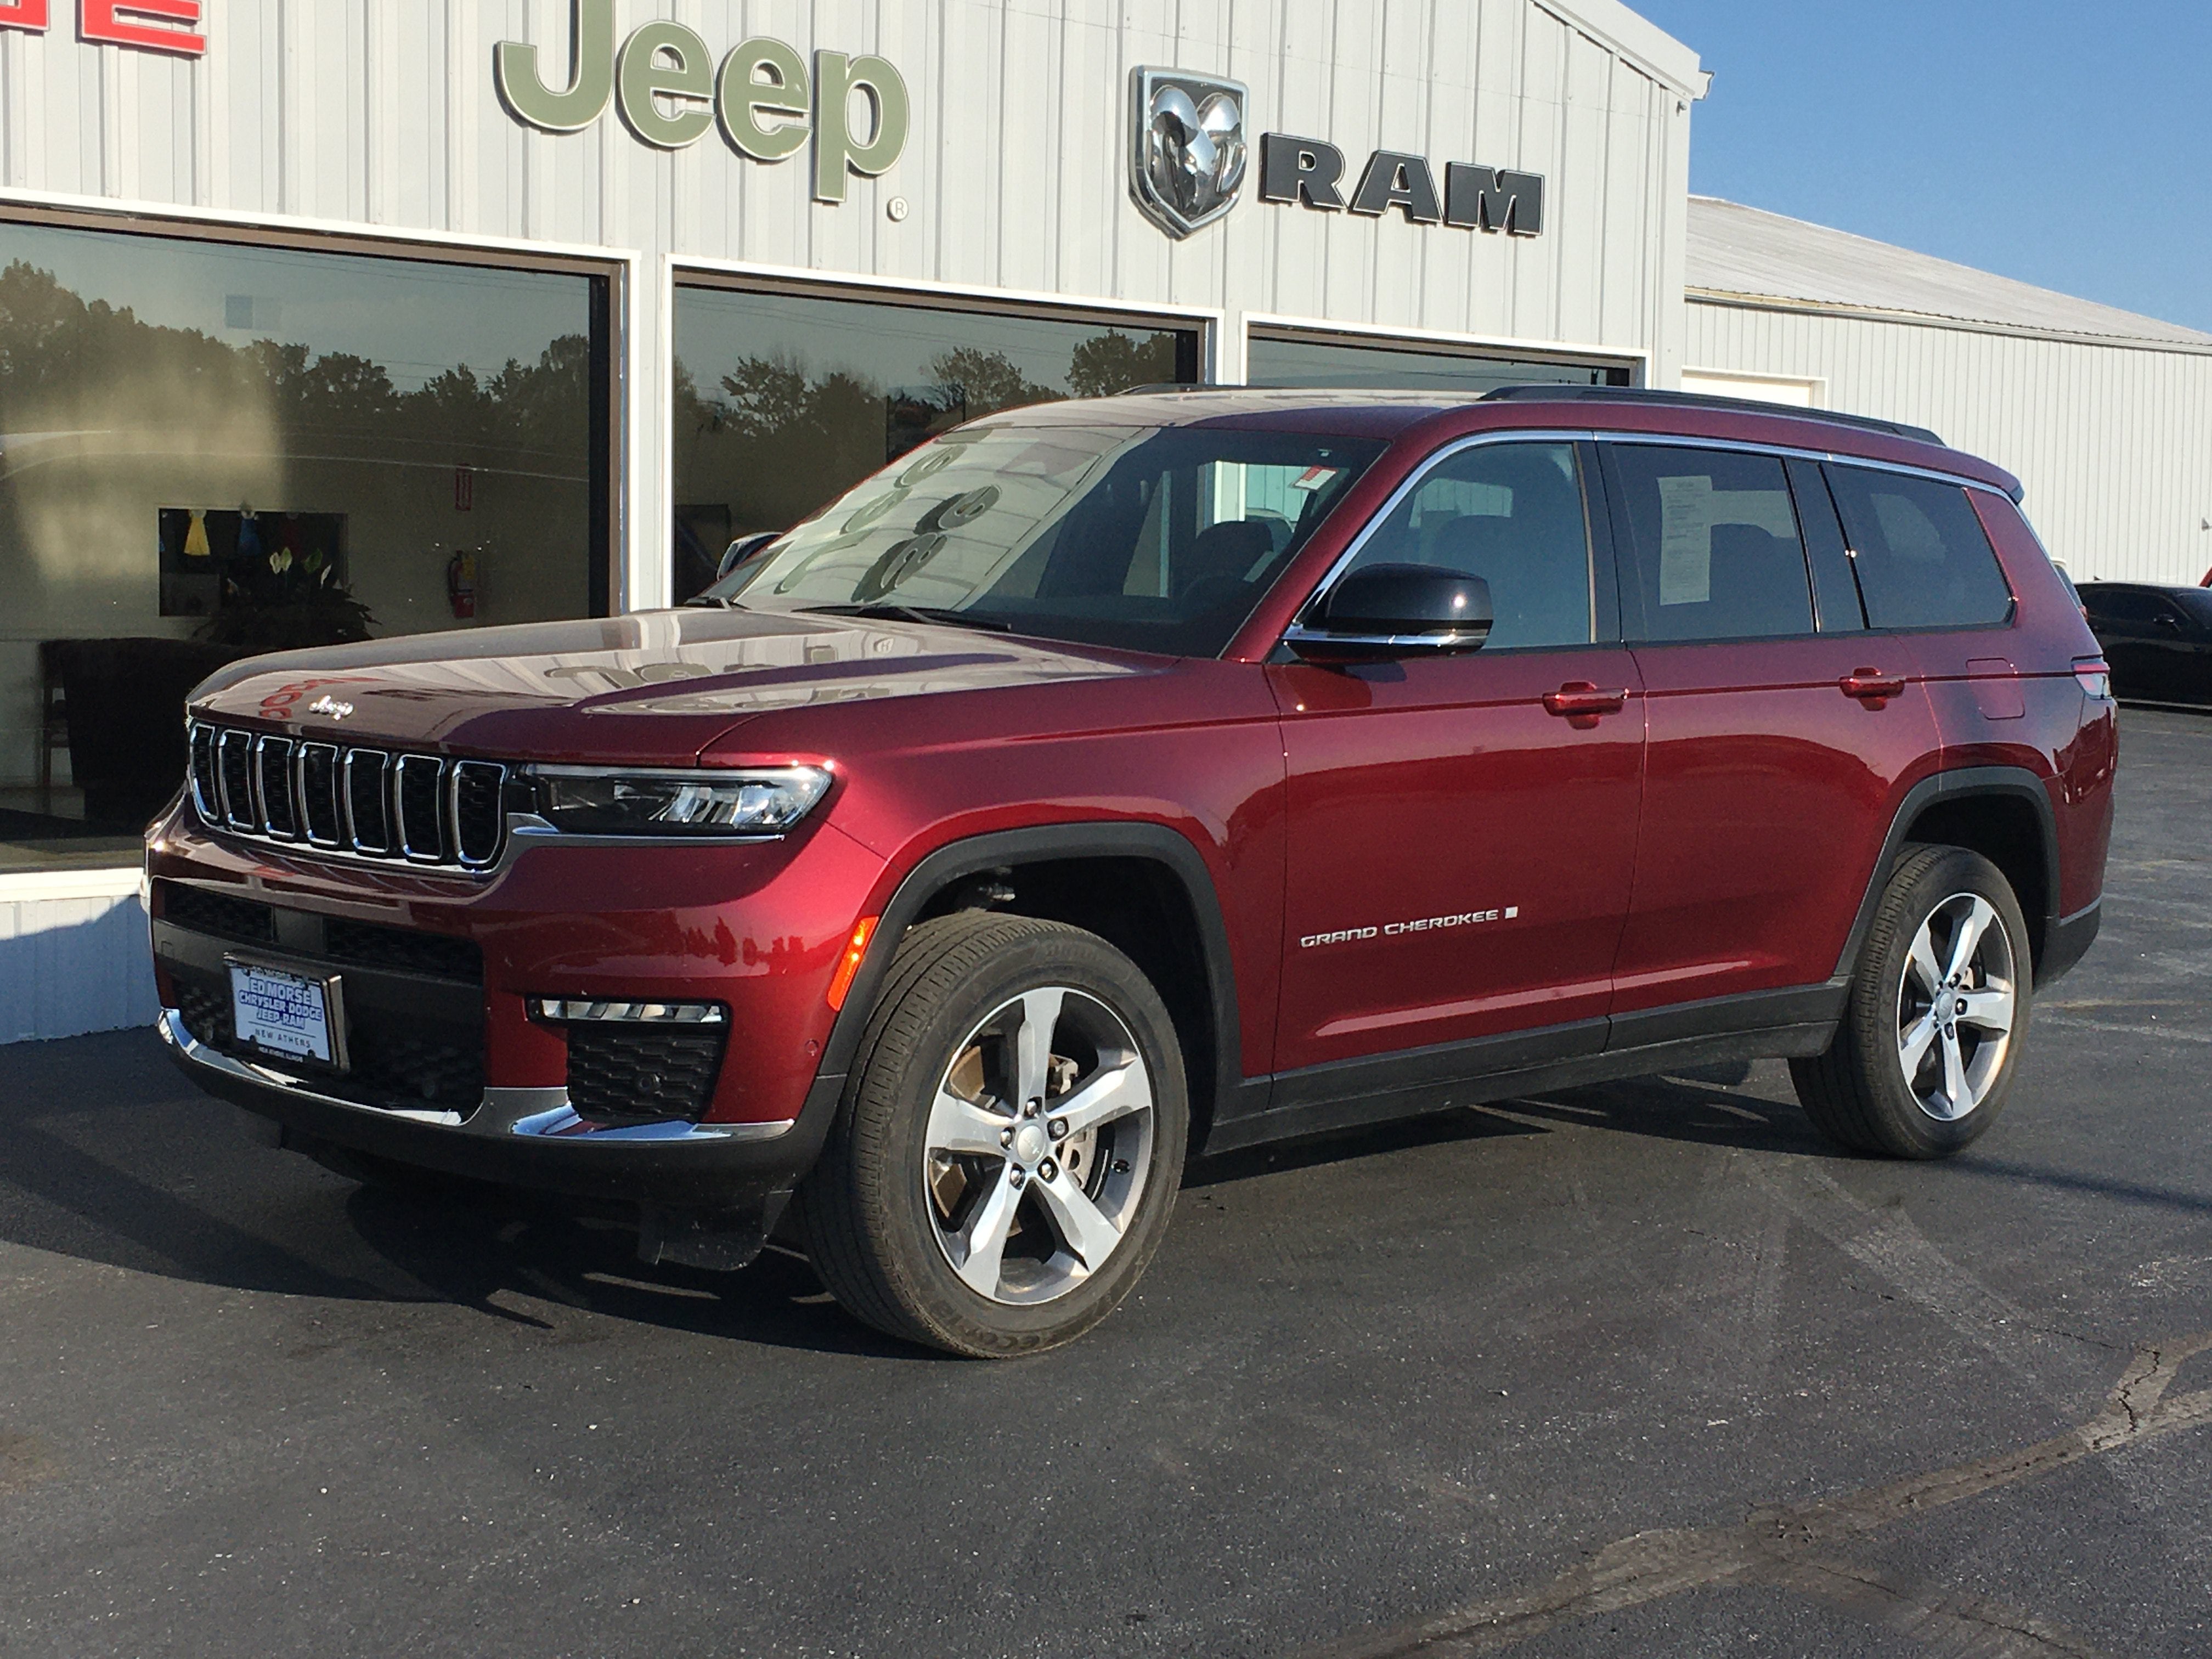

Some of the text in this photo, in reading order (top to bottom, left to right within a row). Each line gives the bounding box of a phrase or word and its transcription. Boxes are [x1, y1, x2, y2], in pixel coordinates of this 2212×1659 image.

[0, 0, 207, 57] E
[495, 0, 910, 204] Jeep
[1260, 132, 1546, 238] RAM
[1300, 926, 1377, 948] GRAND
[1384, 909, 1499, 935] CHEROKEE
[239, 990, 322, 1021] CHRYSLER DODGE
[250, 977, 311, 1005] ED MORSE
[255, 1028, 273, 1039] NEW
[257, 1007, 305, 1030] JEEP RAM
